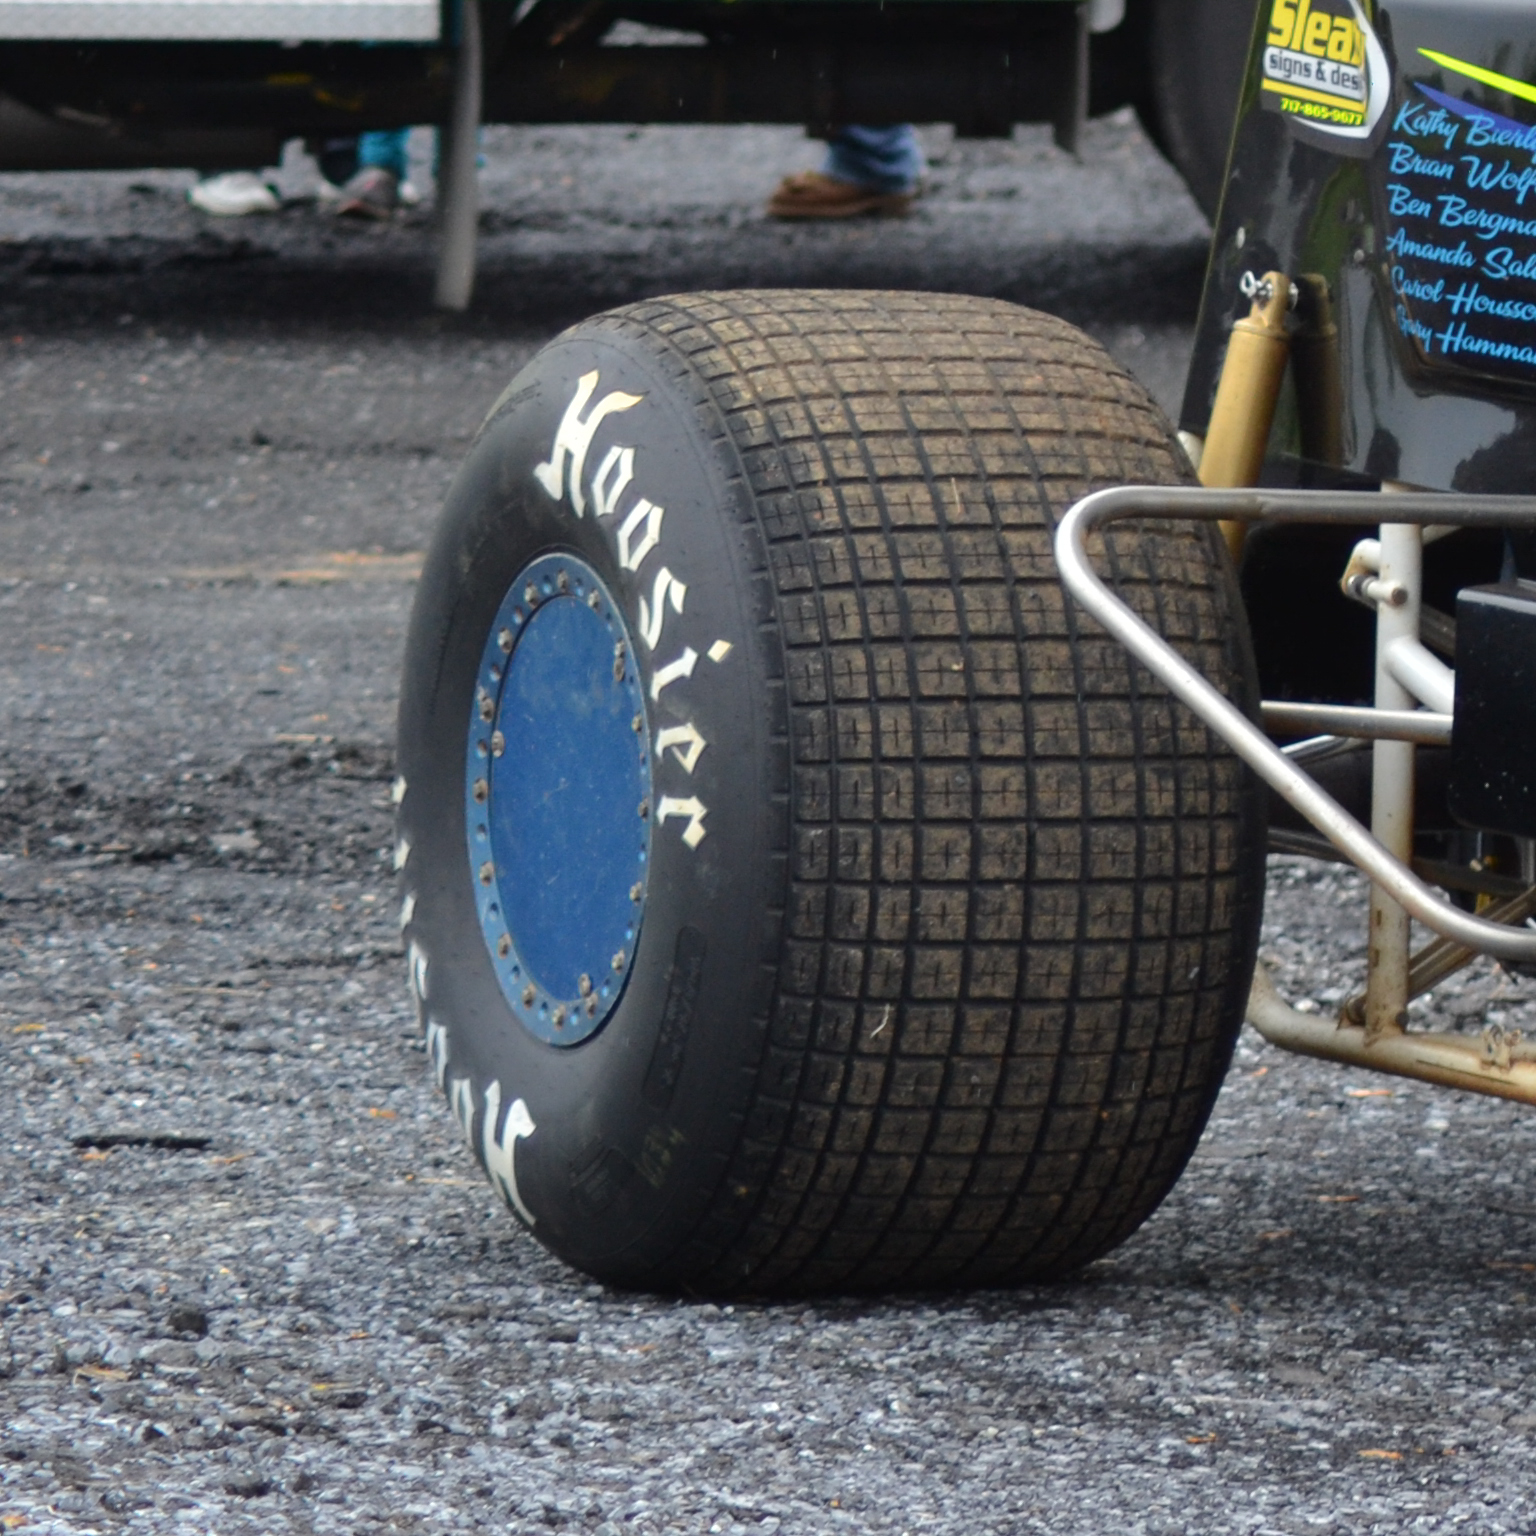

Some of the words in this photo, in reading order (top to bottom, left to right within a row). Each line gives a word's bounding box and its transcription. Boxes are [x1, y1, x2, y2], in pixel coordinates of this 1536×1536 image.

[1269, 50, 1312, 79] signs
[1315, 60, 1327, 83] &
[1393, 100, 1460, 150] Kathy
[1388, 142, 1455, 180] Brian
[1387, 184, 1432, 219] Ben
[1387, 227, 1477, 268] Amanda
[1391, 266, 1446, 302] Carol
[533, 369, 734, 850] Hoosier
